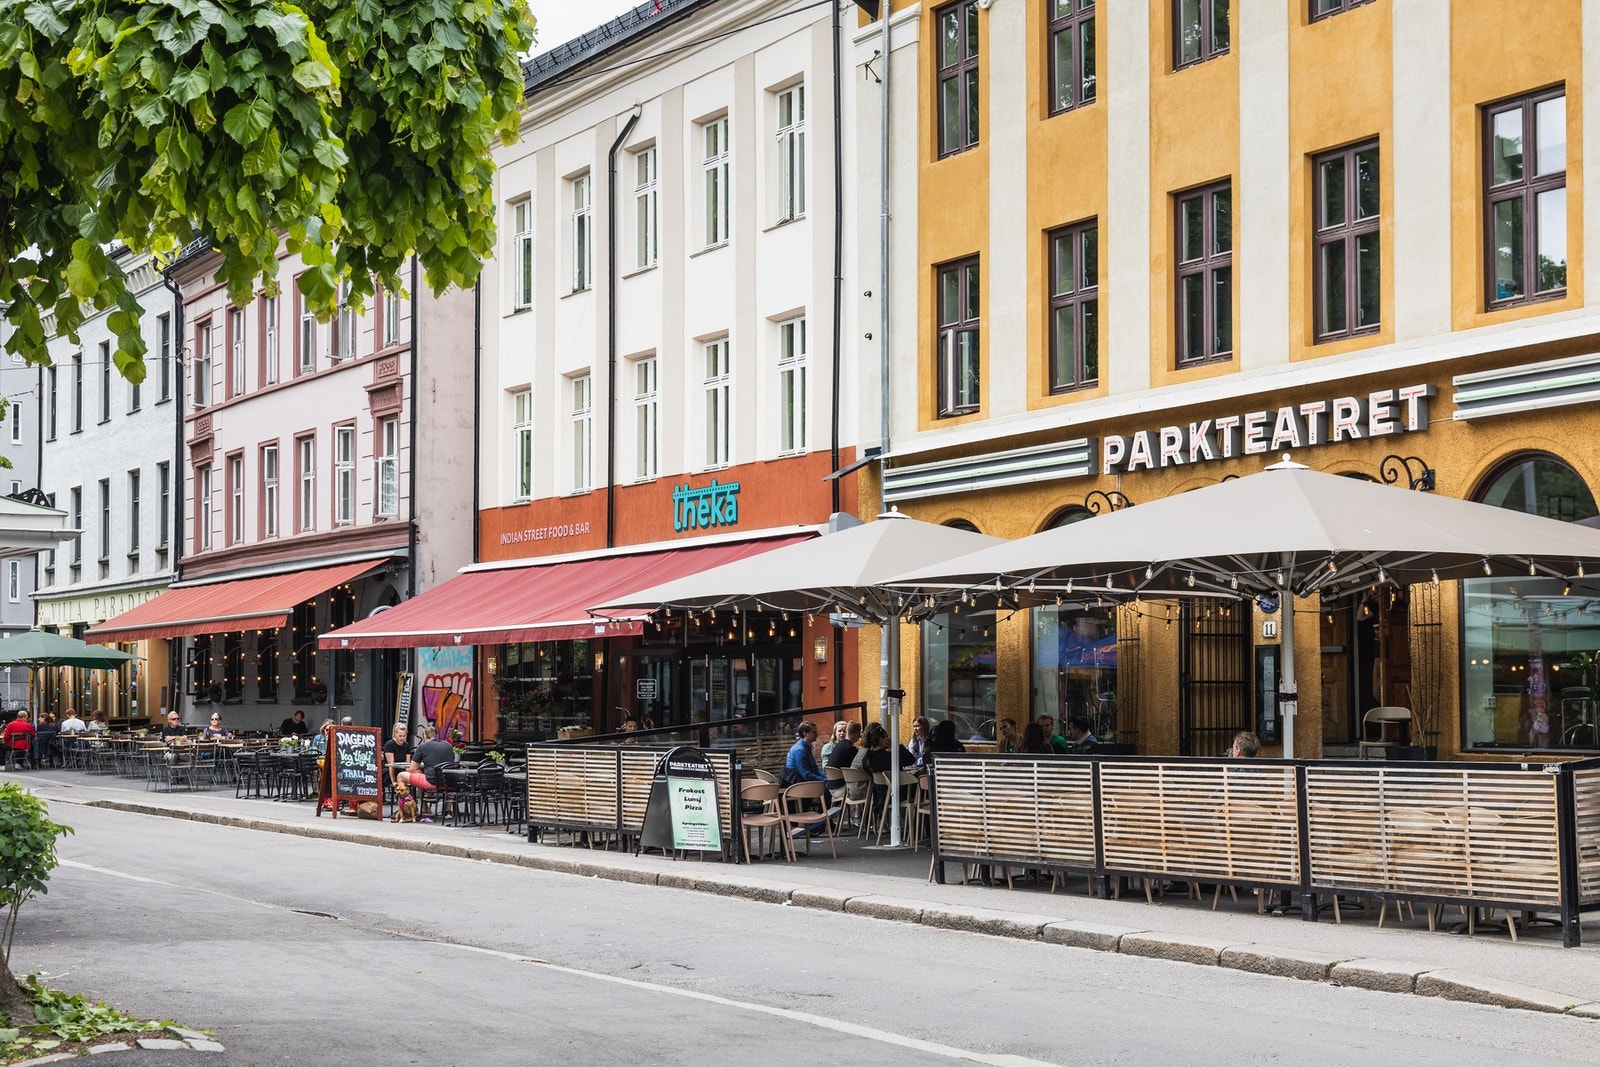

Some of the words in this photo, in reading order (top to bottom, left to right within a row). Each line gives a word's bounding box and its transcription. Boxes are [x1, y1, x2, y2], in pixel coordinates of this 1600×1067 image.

[1103, 383, 1430, 475] PARKTEATRET
[673, 478, 740, 532] theka
[500, 531, 523, 544] INDIAN
[523, 527, 547, 542] STREET
[548, 525, 568, 538] FOOD
[569, 524, 574, 536] &
[575, 522, 590, 535] BAR
[51, 601, 82, 621] VILLA
[1264, 623, 1274, 636] 11
[336, 732, 375, 748] DAGENS
[338, 748, 353, 766] Veg
[669, 761, 708, 769] PARKTEATRET
[343, 769, 364, 778] THALI
